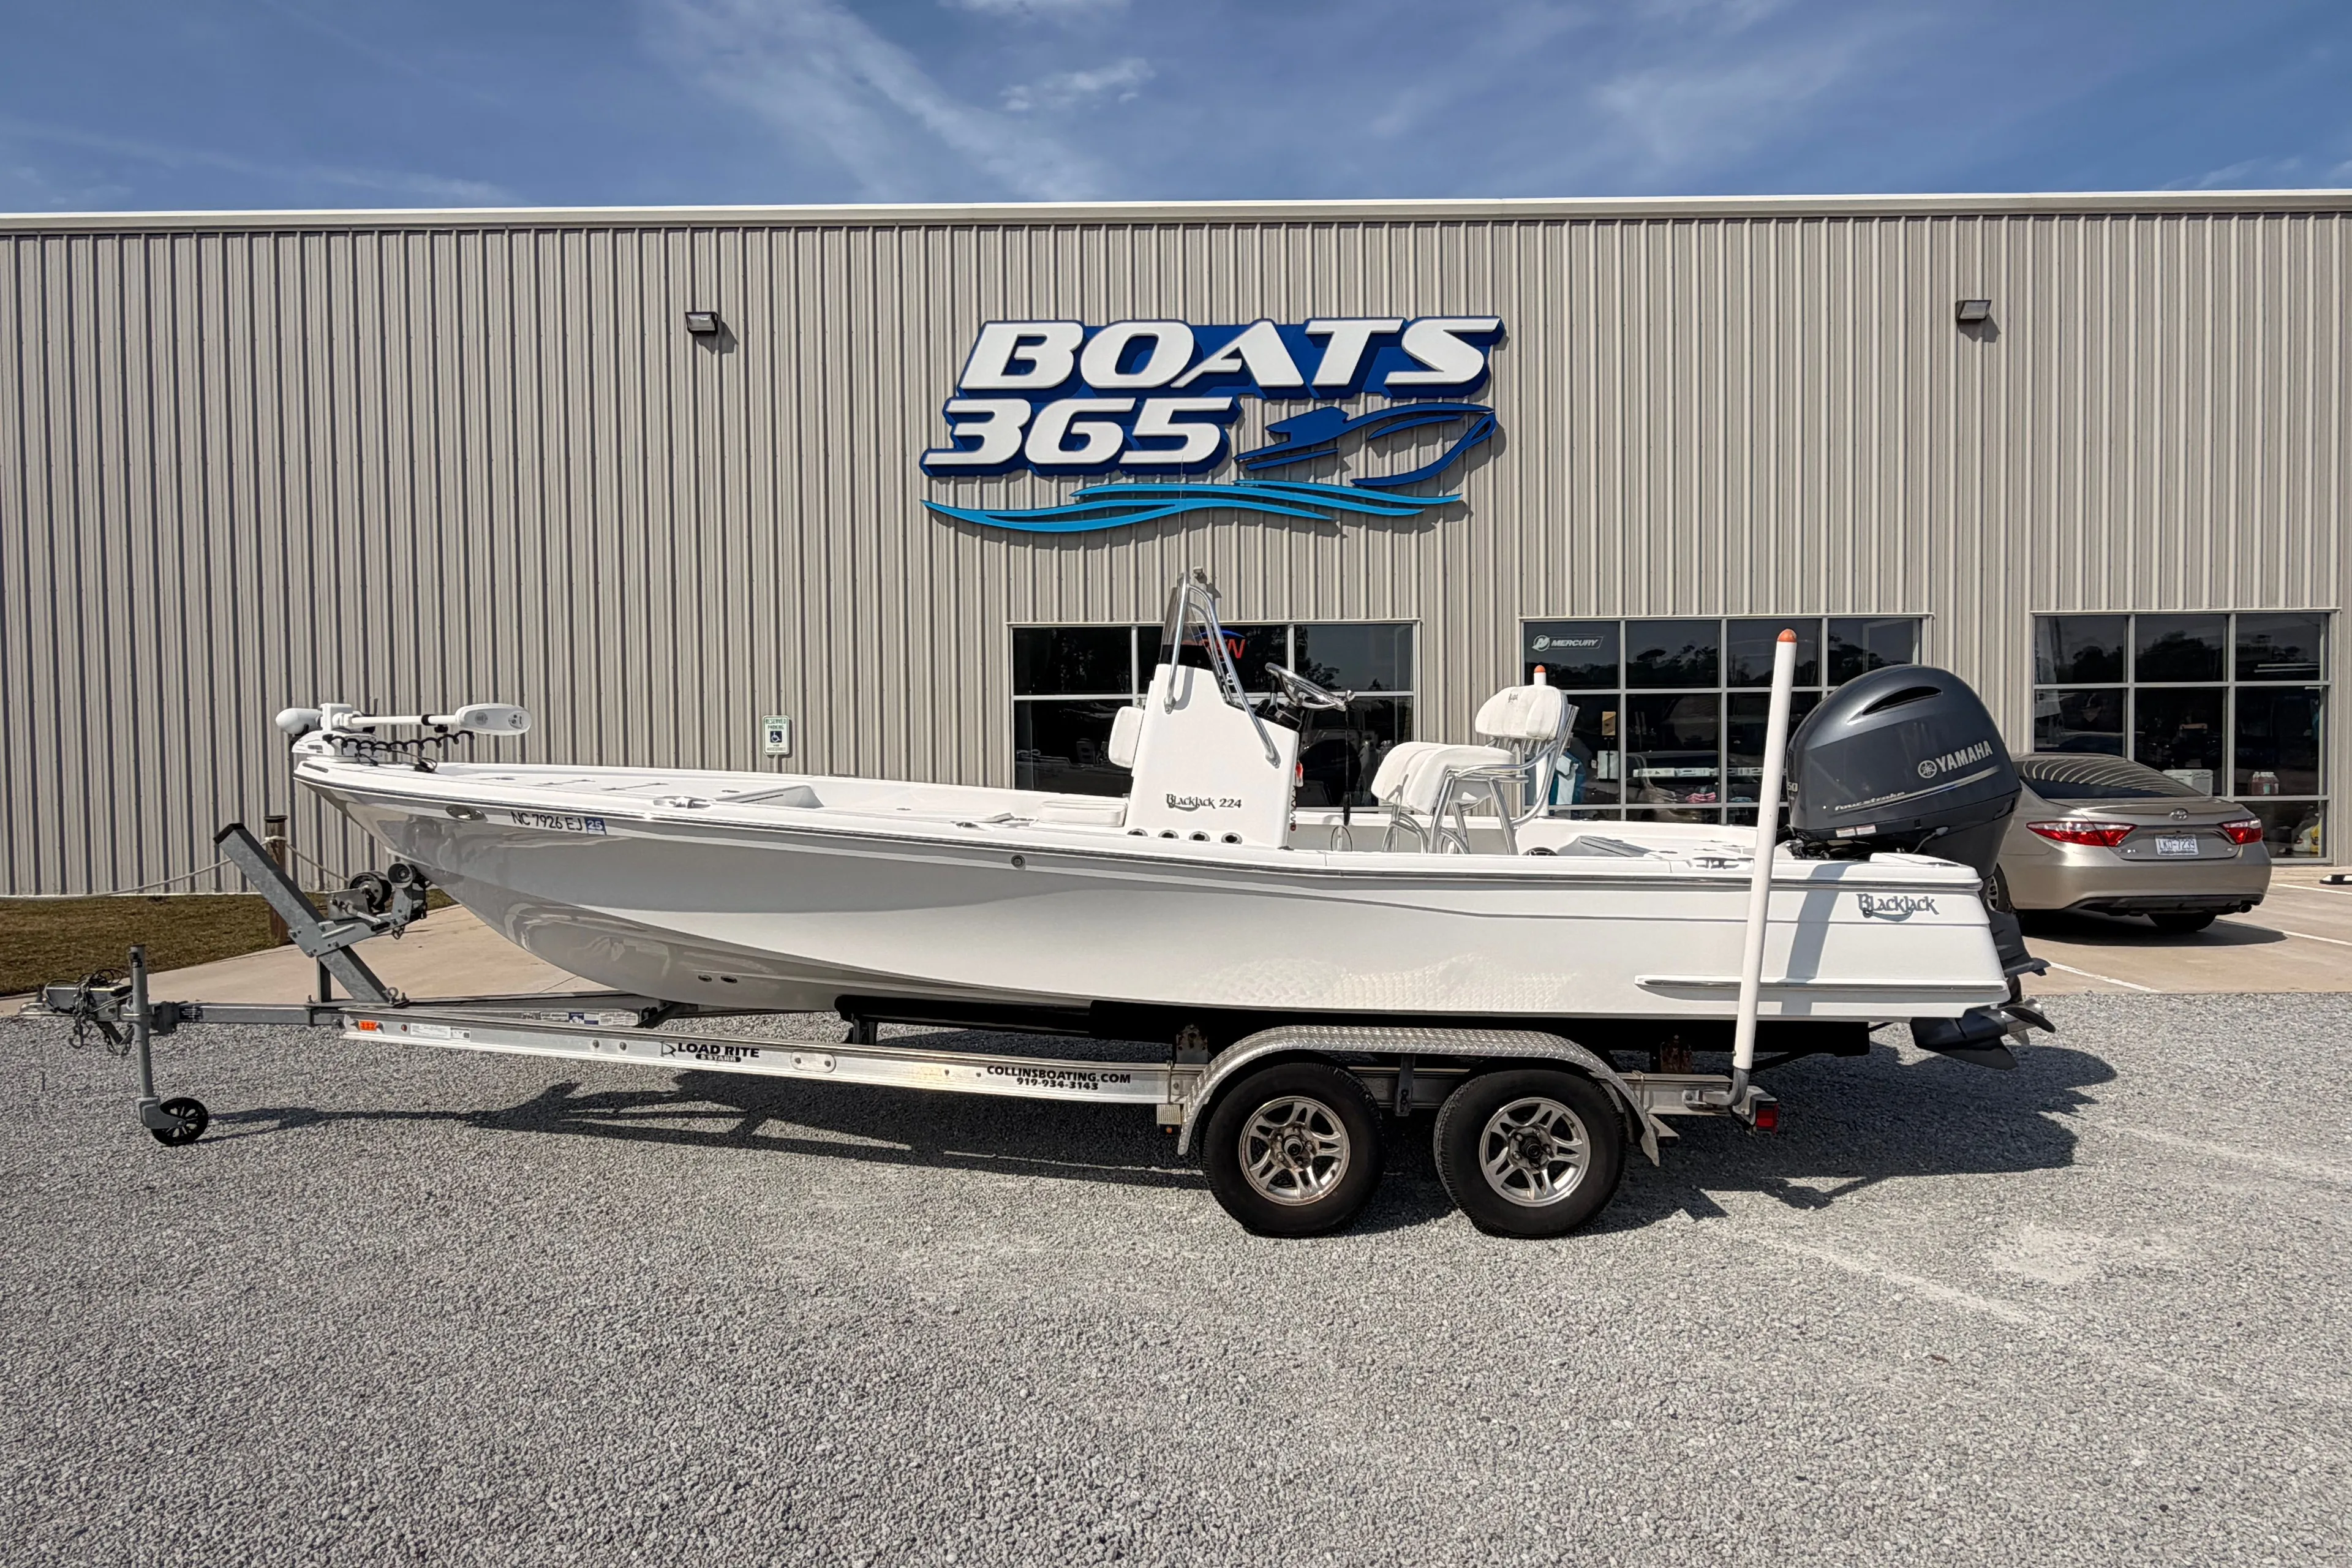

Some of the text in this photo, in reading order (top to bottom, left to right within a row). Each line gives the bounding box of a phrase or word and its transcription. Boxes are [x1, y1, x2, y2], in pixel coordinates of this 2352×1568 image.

[960, 316, 1503, 391] BOATS
[924, 396, 1235, 466] 365
[1936, 741, 1993, 772] YAMAHA
[1219, 798, 1242, 809] 224
[510, 811, 583, 831] NC 7926 EJ
[587, 820, 603, 830] 25
[677, 1042, 760, 1058] LOAD RITE
[987, 1065, 1131, 1084] COLLINSBOATING.COM
[1016, 1077, 1099, 1090] 919-934-3143
